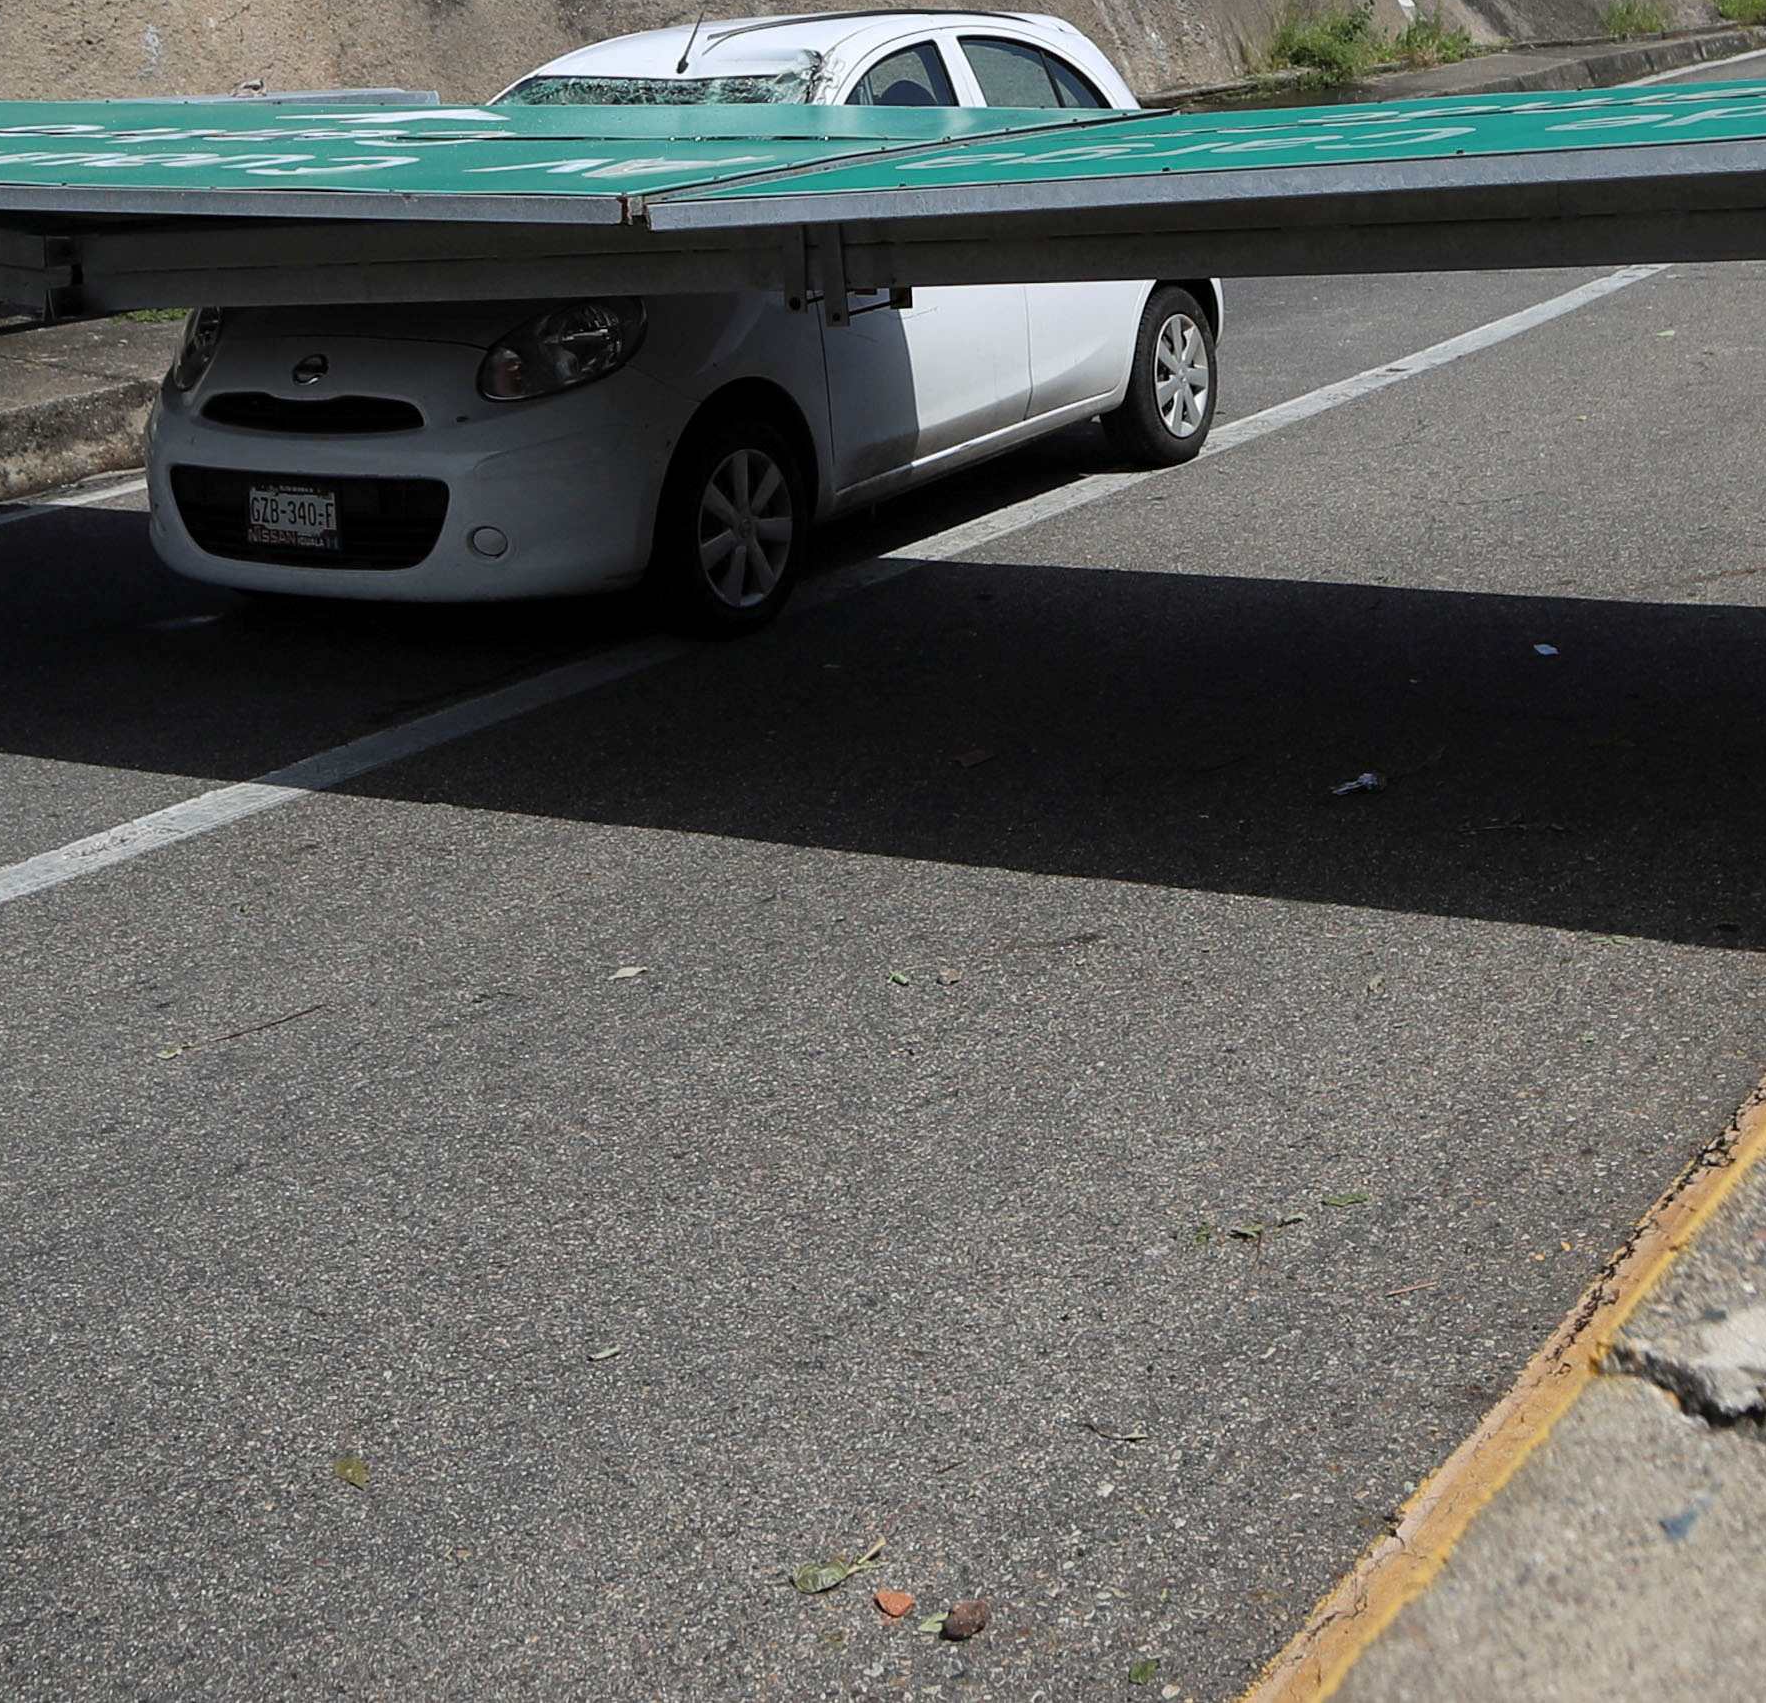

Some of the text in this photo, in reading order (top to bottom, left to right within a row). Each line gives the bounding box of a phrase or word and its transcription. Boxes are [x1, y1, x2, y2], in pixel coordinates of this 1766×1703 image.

[894, 126, 1477, 171] Carga
[462, 154, 776, 178] Av
[249, 528, 297, 546] NISSAN
